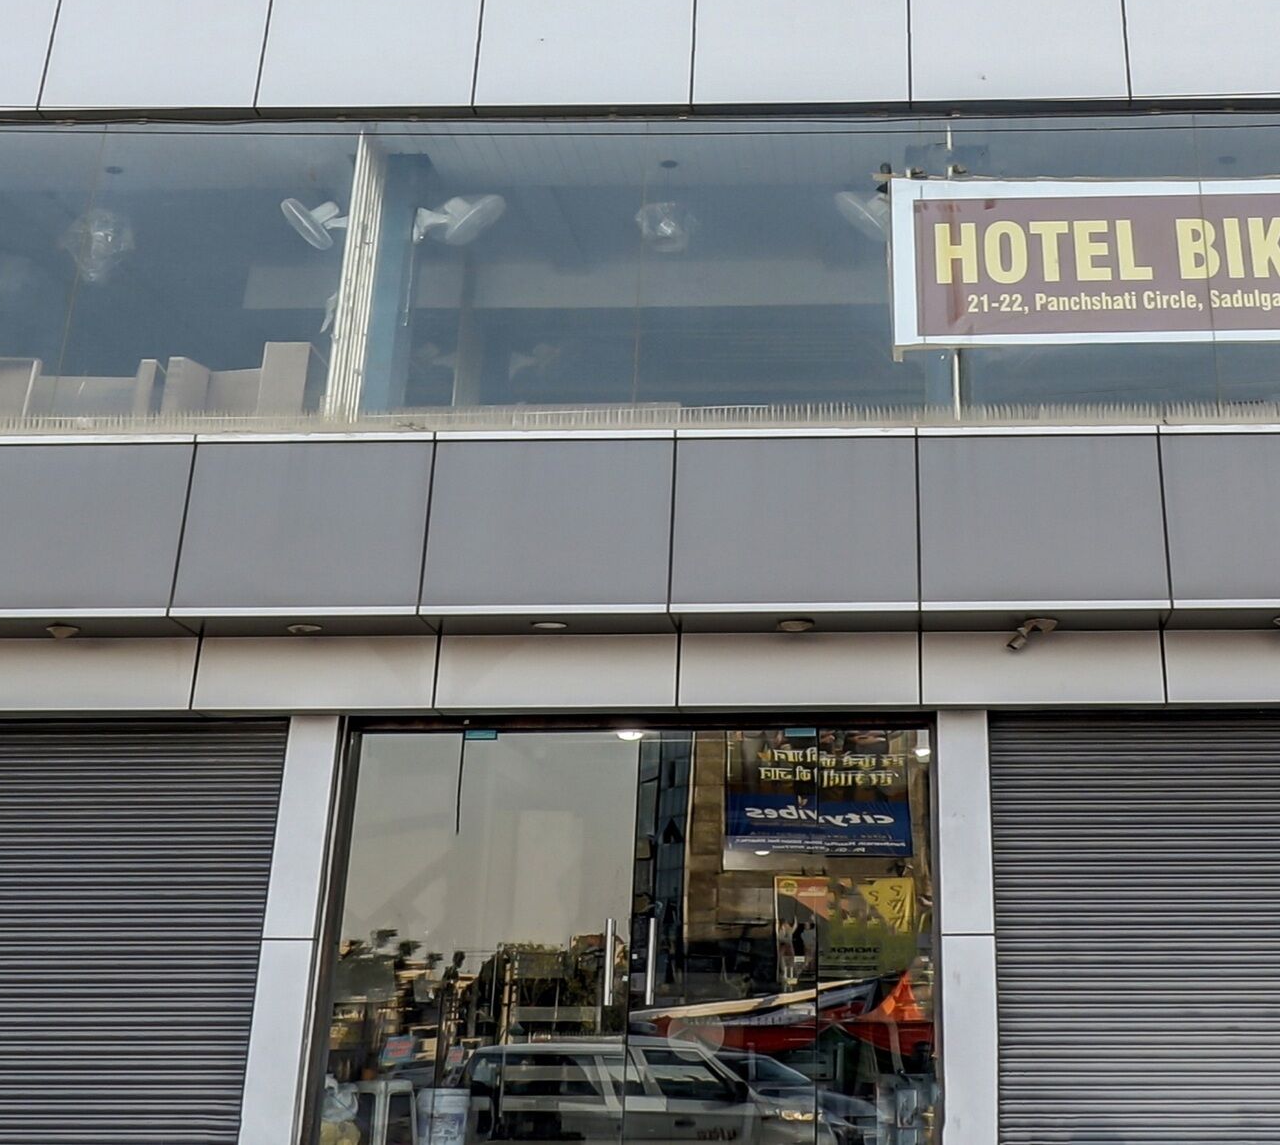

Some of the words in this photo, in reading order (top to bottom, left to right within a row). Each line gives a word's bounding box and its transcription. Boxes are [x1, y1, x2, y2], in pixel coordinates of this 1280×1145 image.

[934, 219, 1153, 284] HOTEL
[967, 294, 1029, 314] 21-22,
[1035, 291, 1137, 311] Panchshati
[1143, 290, 1203, 311] Circle,
